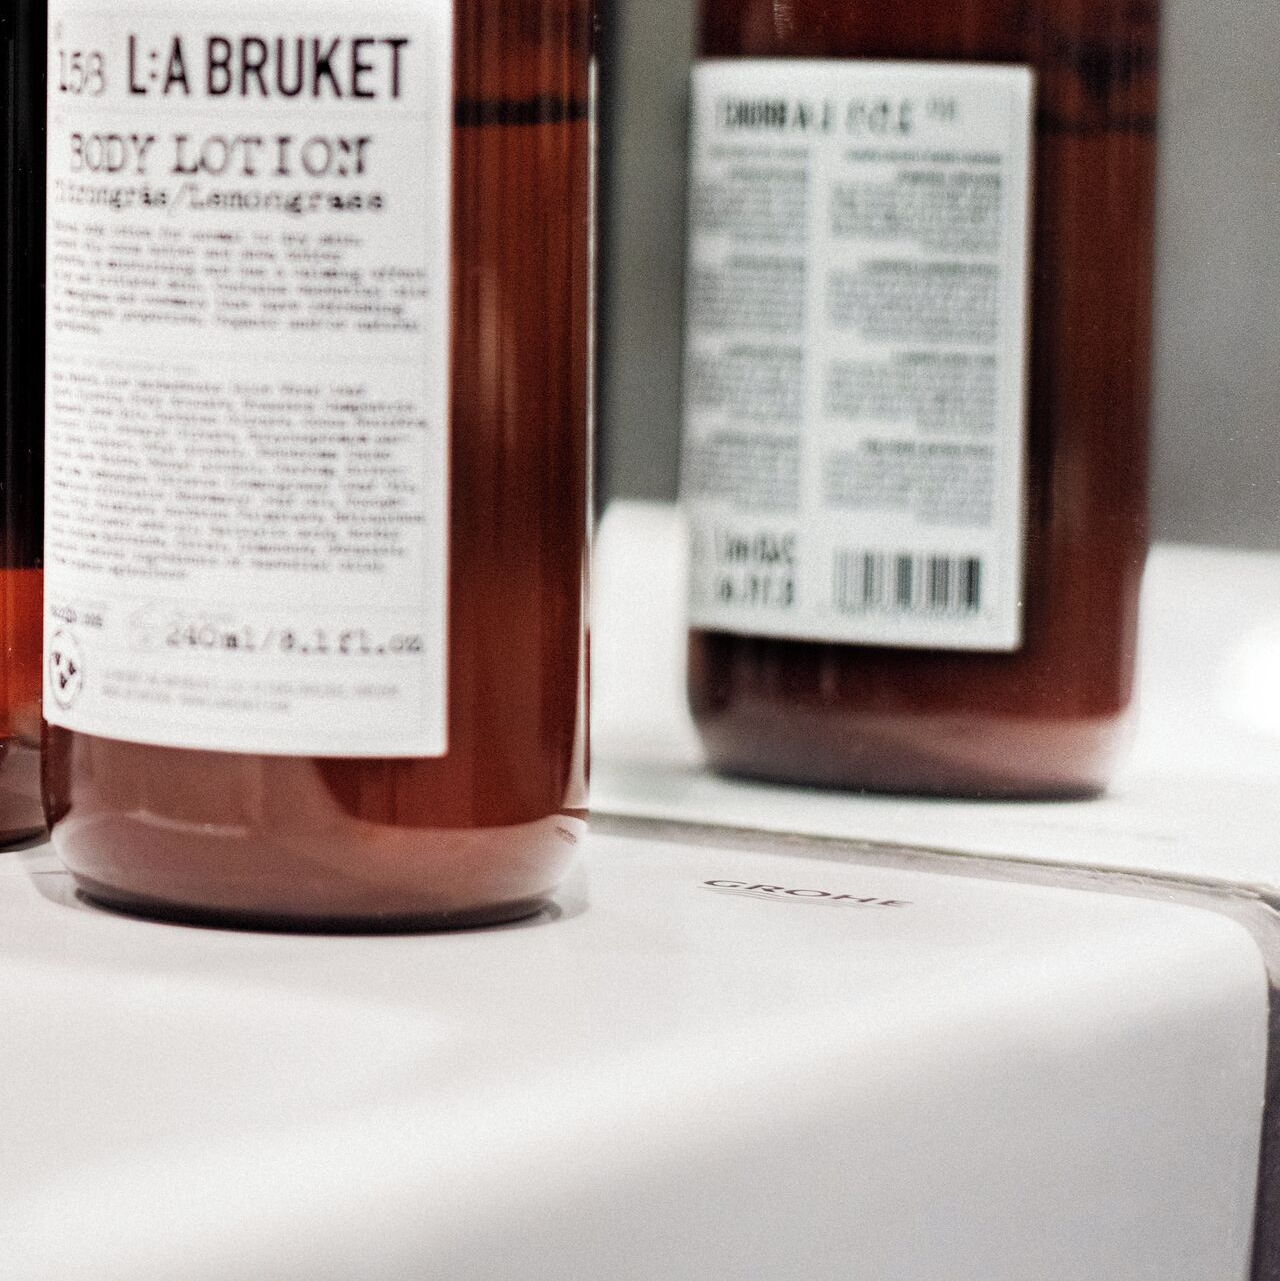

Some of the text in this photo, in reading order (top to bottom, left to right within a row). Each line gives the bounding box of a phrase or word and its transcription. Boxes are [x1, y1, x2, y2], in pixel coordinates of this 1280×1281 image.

[128, 35, 191, 95] L:A
[207, 35, 410, 99] BRUKET
[70, 133, 372, 177] BODY LOTION
[703, 879, 913, 907] GROHE
